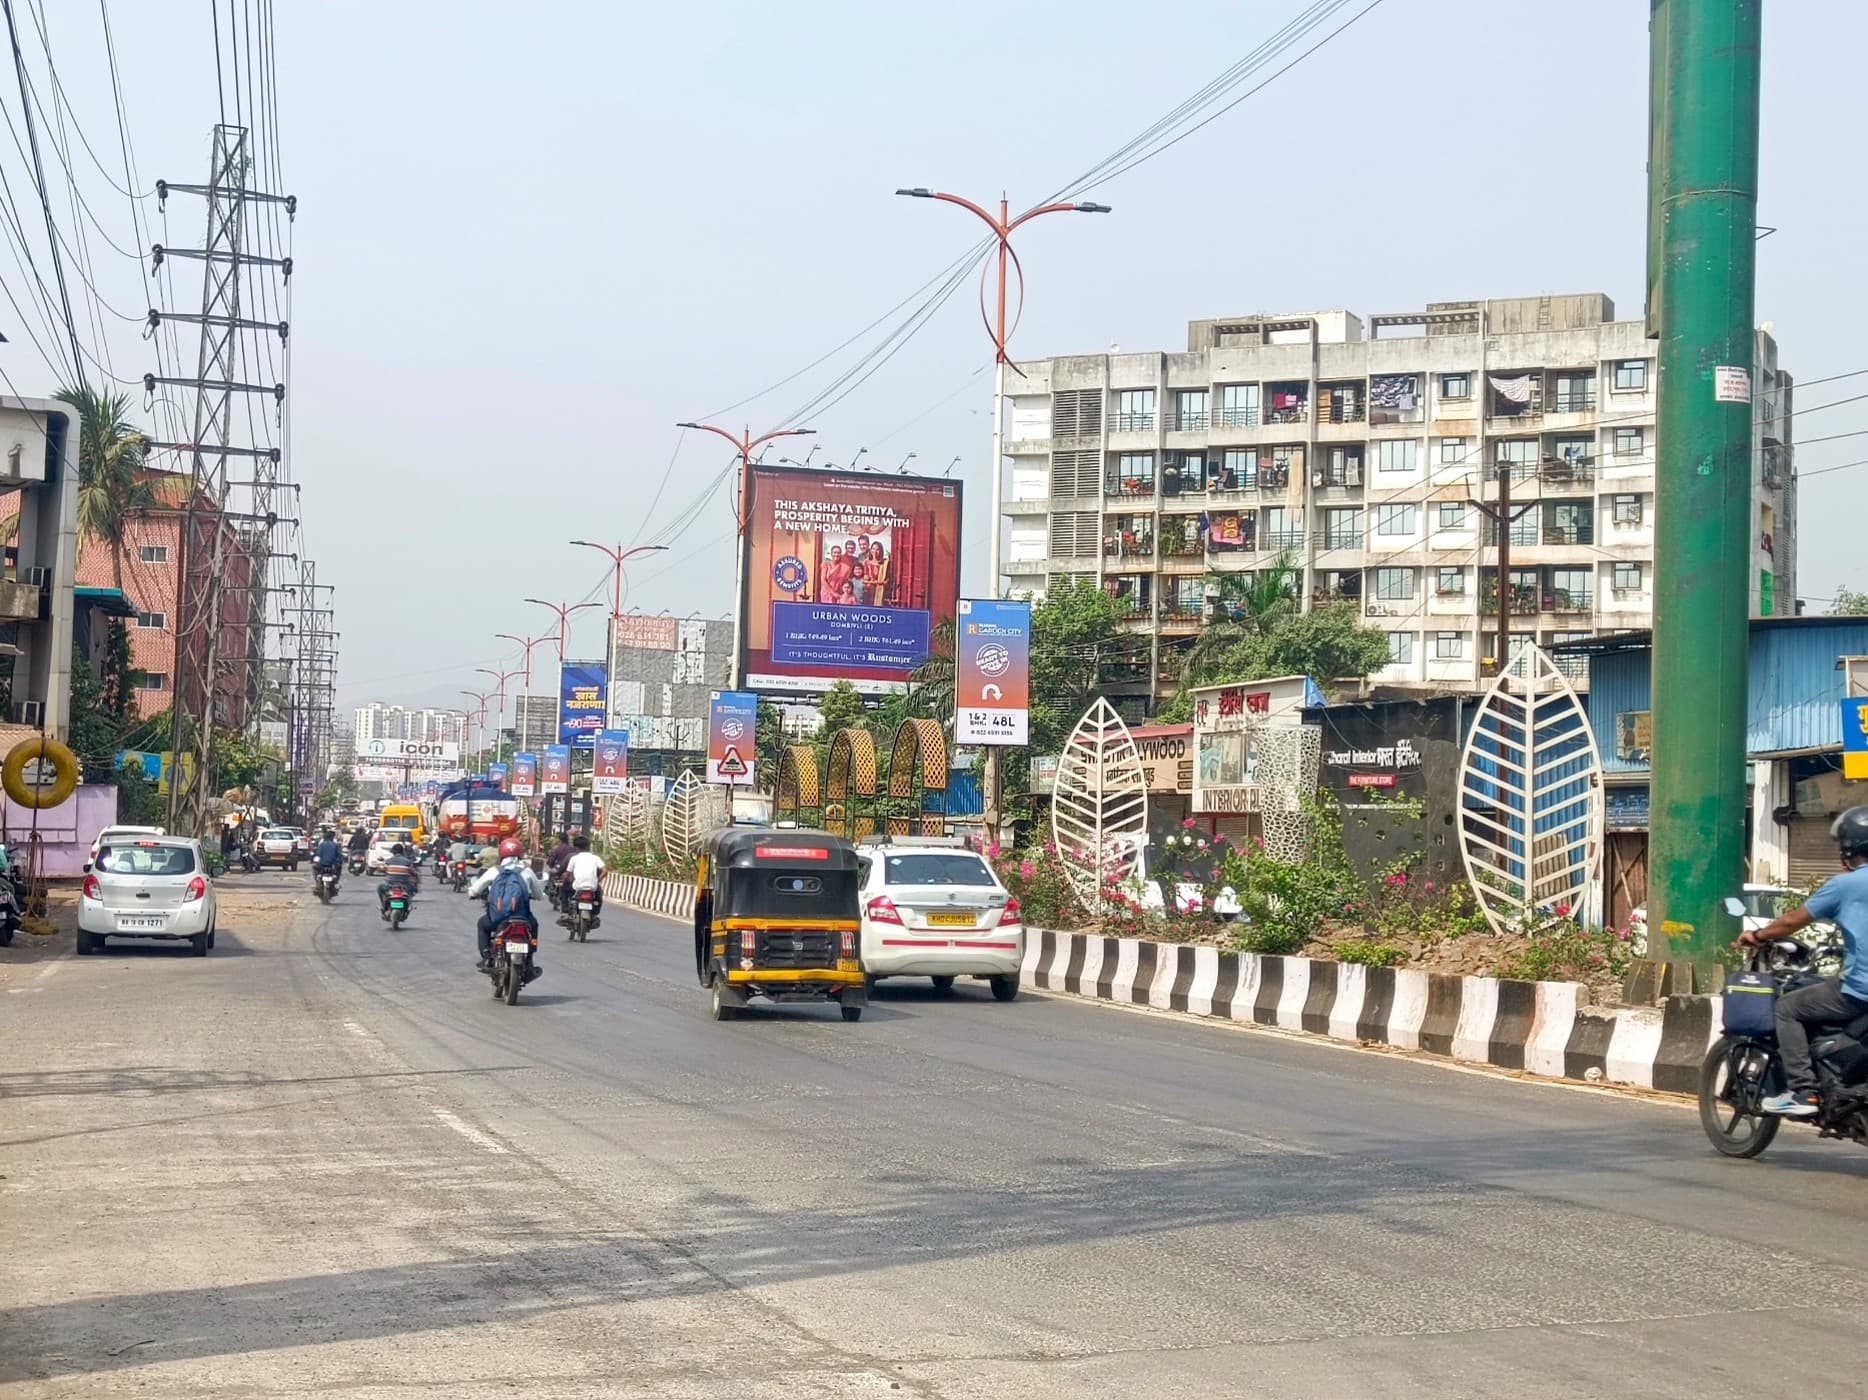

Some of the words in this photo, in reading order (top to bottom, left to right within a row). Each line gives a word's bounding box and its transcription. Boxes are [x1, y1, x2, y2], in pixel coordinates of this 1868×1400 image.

[774, 499, 798, 510] THIS
[801, 502, 852, 514] AKSHAYA
[855, 505, 897, 518] TRITIYA,
[774, 510, 838, 523] PROSPERITY
[841, 514, 879, 526] BEGINS
[883, 517, 910, 528] WITH
[774, 521, 782, 530] A
[785, 521, 811, 532] NEW
[814, 523, 849, 534] HOME.
[812, 611, 847, 621] URBAN
[851, 613, 892, 624] WOODS
[1007, 628, 1023, 636] CITY
[974, 712, 981, 720] &
[982, 712, 987, 720] 2
[992, 716, 1016, 727] 48L
[399, 741, 443, 756] icon
[1352, 750, 1377, 764] Interior
[1203, 788, 1248, 812] INTERIOR
